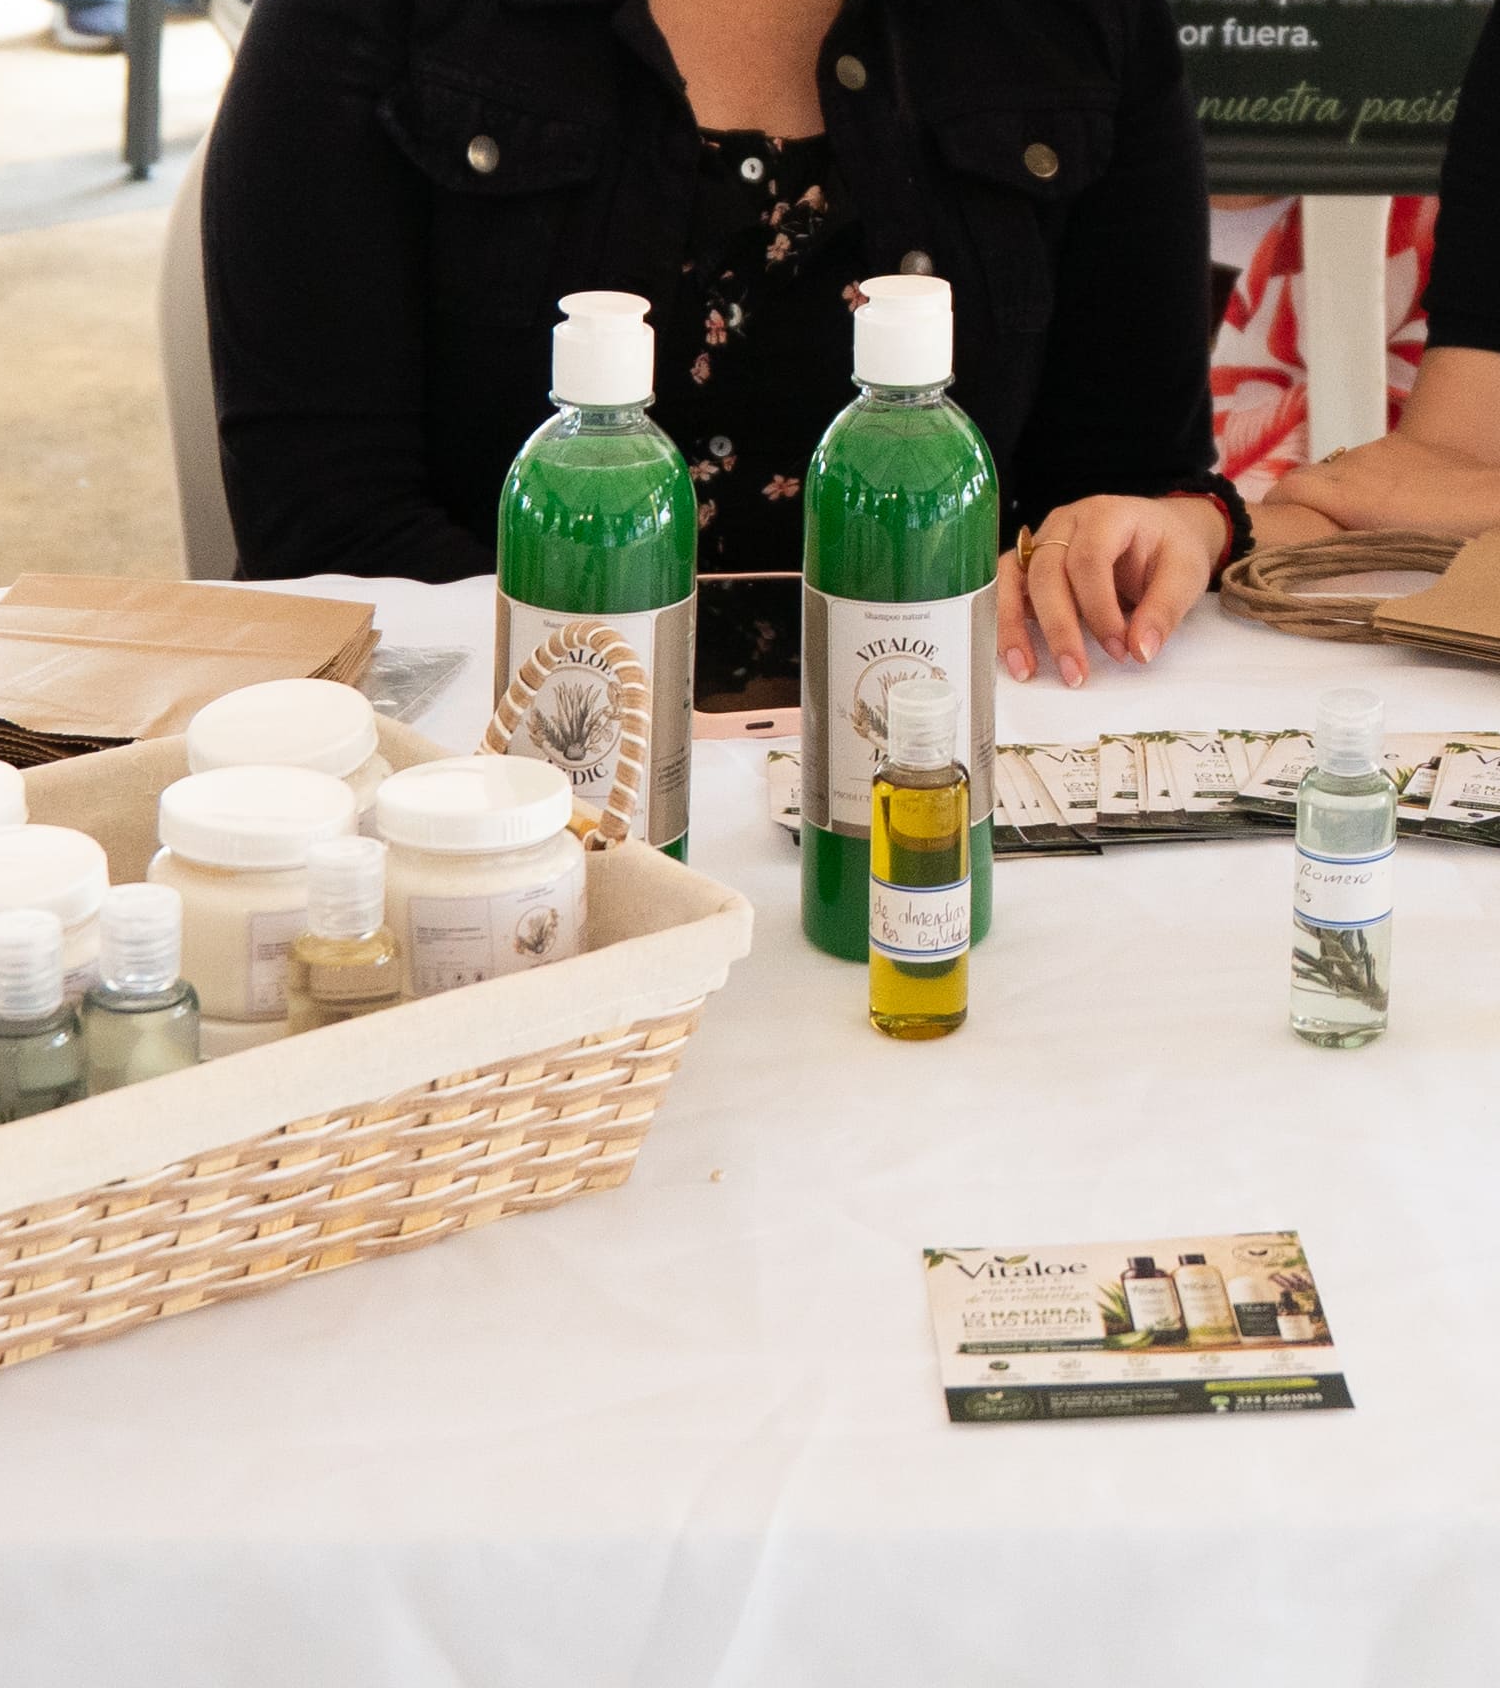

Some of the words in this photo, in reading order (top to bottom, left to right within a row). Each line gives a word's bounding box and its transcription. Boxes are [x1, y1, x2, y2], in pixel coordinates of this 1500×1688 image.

[1178, 23, 1214, 46] or
[1222, 18, 1319, 48] fuera.
[1197, 80, 1342, 123] nuestra
[1346, 86, 1462, 146] pasió
[864, 611, 900, 622] Shampoo
[901, 611, 931, 621] natural
[856, 637, 940, 662] VITALOE
[1300, 862, 1373, 885] Romero
[873, 895, 890, 920] de
[956, 1260, 1088, 1280] Vitaloe
